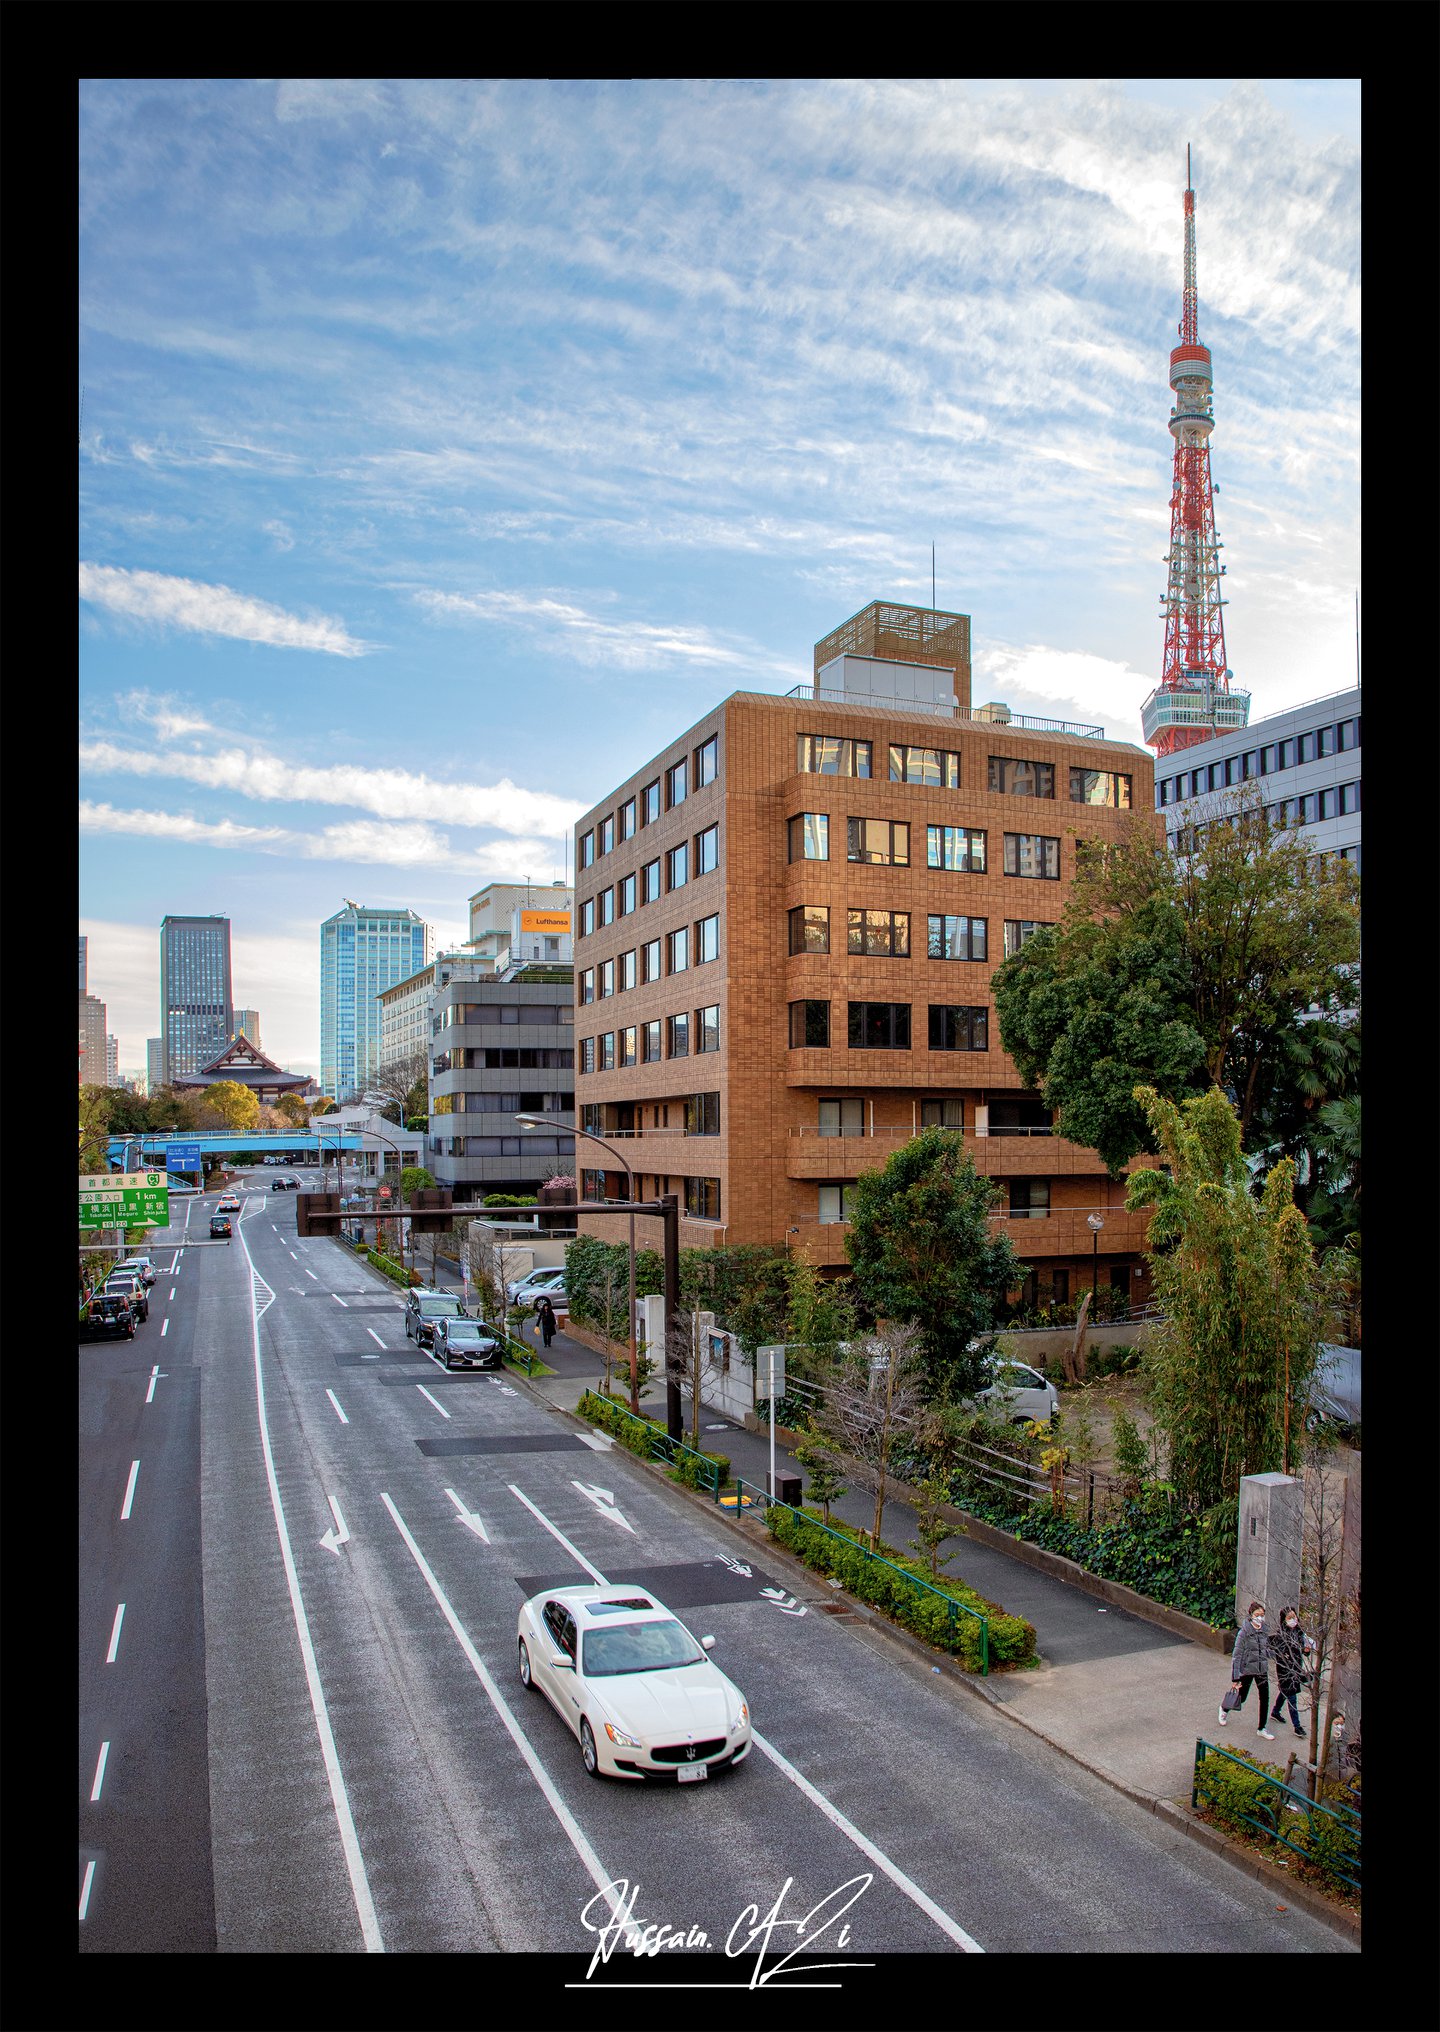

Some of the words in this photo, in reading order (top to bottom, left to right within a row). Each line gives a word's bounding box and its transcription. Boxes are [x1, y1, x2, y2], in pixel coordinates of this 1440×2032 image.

[88, 1177, 137, 1187] 首都高速
[149, 1175, 159, 1183] C1
[136, 1191, 141, 1200] 1
